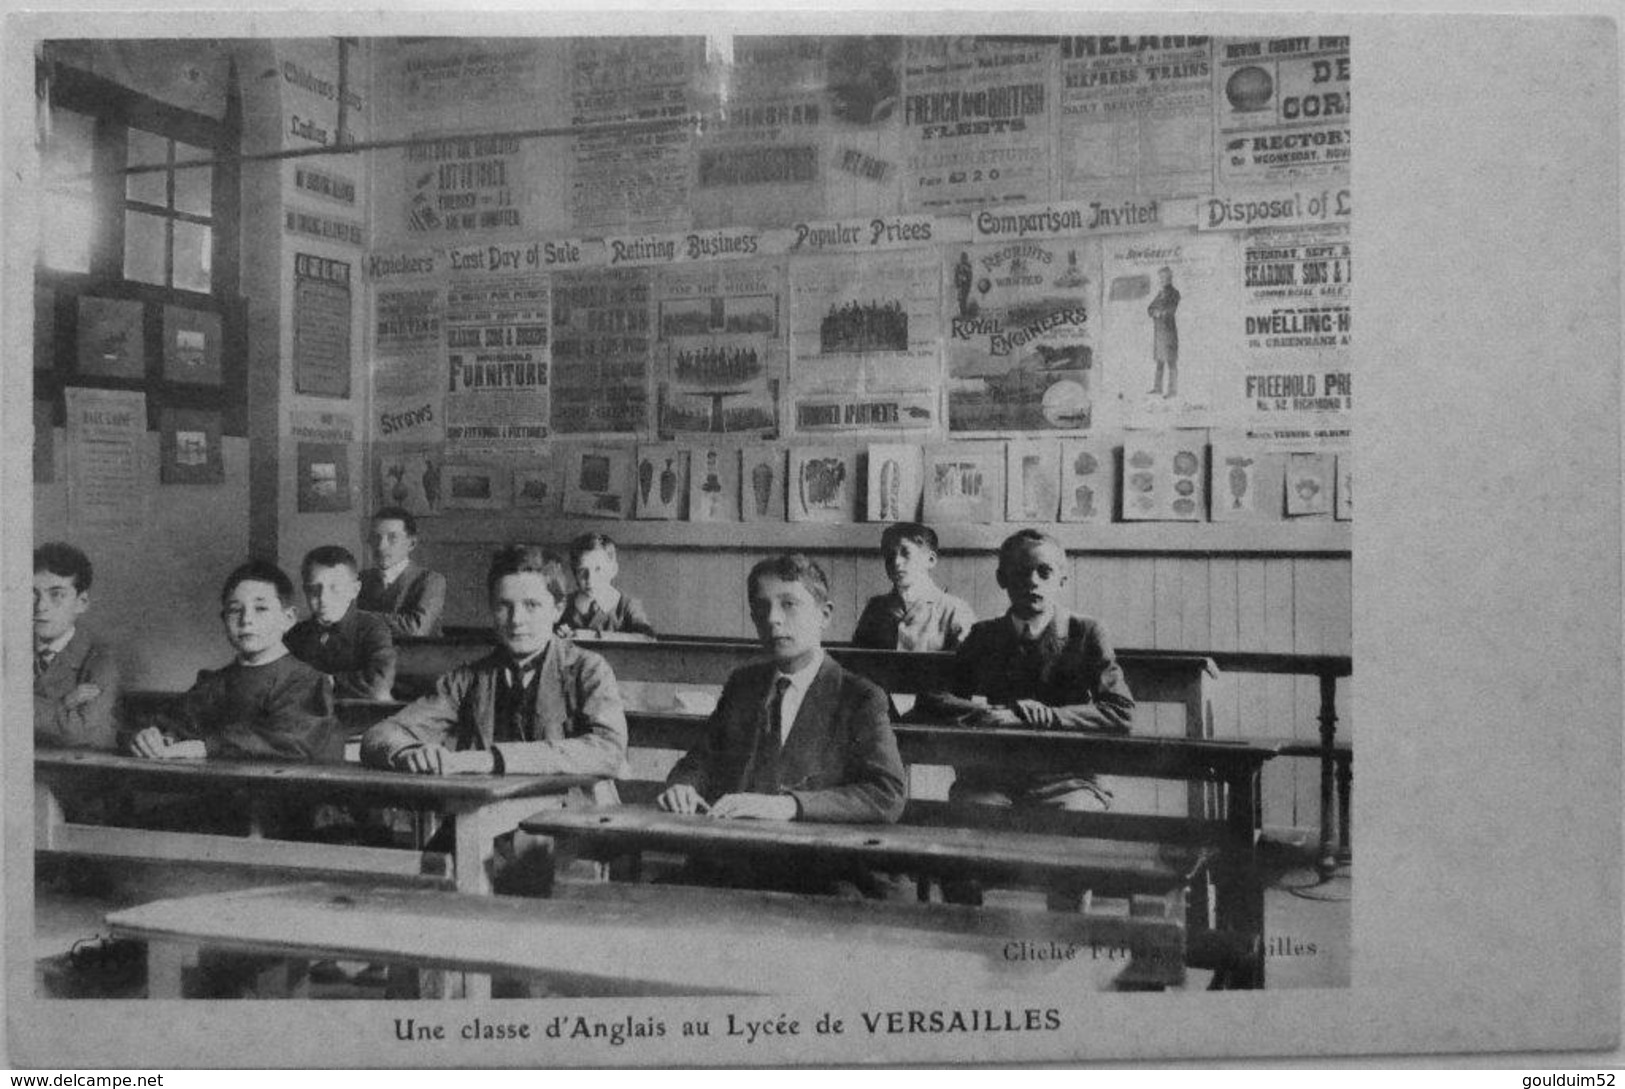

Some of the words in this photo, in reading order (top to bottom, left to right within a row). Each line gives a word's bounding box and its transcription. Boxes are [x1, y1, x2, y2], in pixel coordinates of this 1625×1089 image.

[1065, 69, 1138, 88] EXPRESS
[1146, 62, 1209, 81] TRAINS
[988, 83, 1044, 118] BRITISH
[1283, 91, 1350, 119] COR
[922, 117, 1027, 140] FLEETS
[977, 206, 1082, 236] Comparison
[1089, 202, 1158, 229] Invited
[1208, 192, 1302, 227] Disposal
[1308, 191, 1329, 219] of
[611, 237, 675, 264] Retiring
[687, 231, 758, 258] Business
[796, 223, 862, 250] Popular
[870, 218, 932, 245] Prices
[369, 253, 433, 277] Knickers
[450, 247, 484, 270] Last
[488, 245, 521, 271] Day
[527, 247, 540, 268] of
[544, 242, 580, 263] Sale
[980, 244, 1053, 272] RECRUITS
[997, 275, 1044, 287] WANTED
[952, 318, 1004, 340] ROYAL
[990, 306, 1088, 357] ENGINEERS
[450, 354, 548, 392] FURNITURE
[1246, 374, 1316, 398] FREEHOLD
